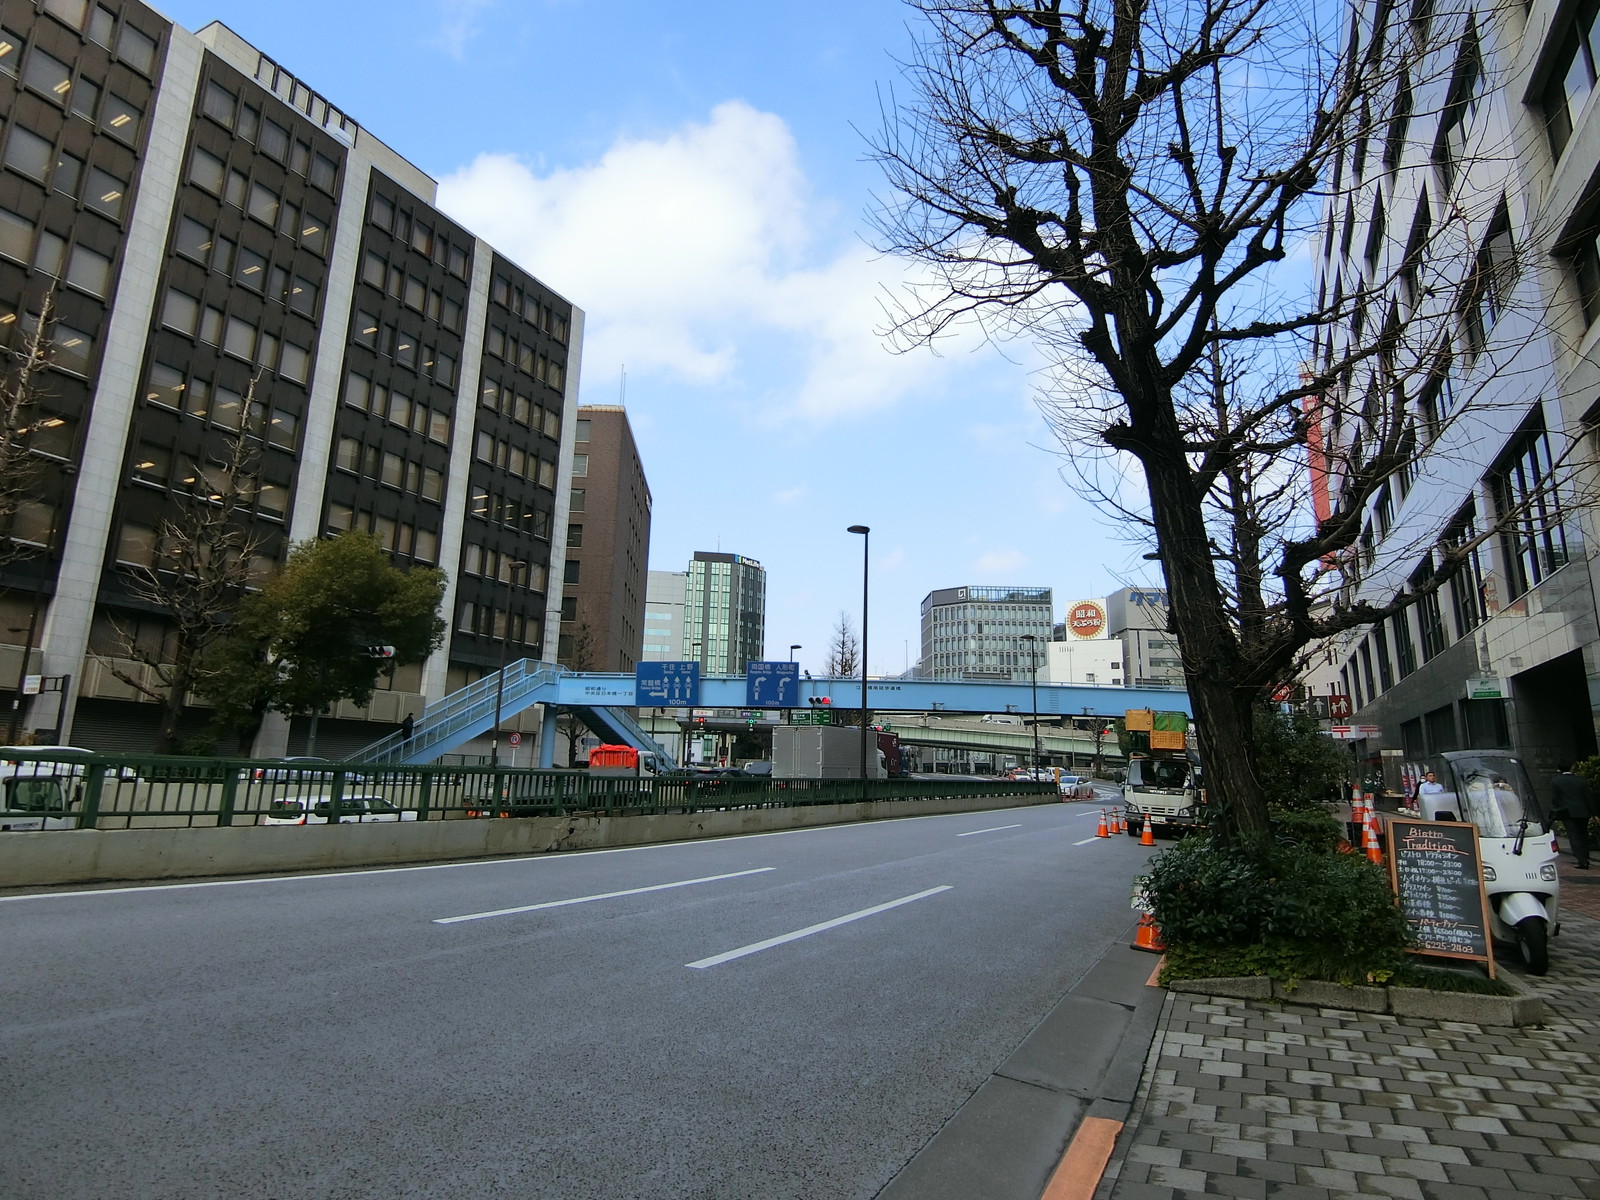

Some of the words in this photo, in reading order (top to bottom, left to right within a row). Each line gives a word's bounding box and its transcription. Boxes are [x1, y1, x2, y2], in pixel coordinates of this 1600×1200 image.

[742, 557, 760, 569] MetLife
[1075, 609, 1096, 618] 昭和
[1072, 618, 1101, 628] 天ぷら粉
[661, 663, 676, 671] 千住
[680, 663, 693, 671] 上野
[751, 663, 771, 671] 両国橋
[775, 663, 795, 671] 人形町
[1409, 827, 1443, 838] Bistro
[1402, 838, 1456, 851] Tradition
[1400, 850, 1421, 859] ビストロ
